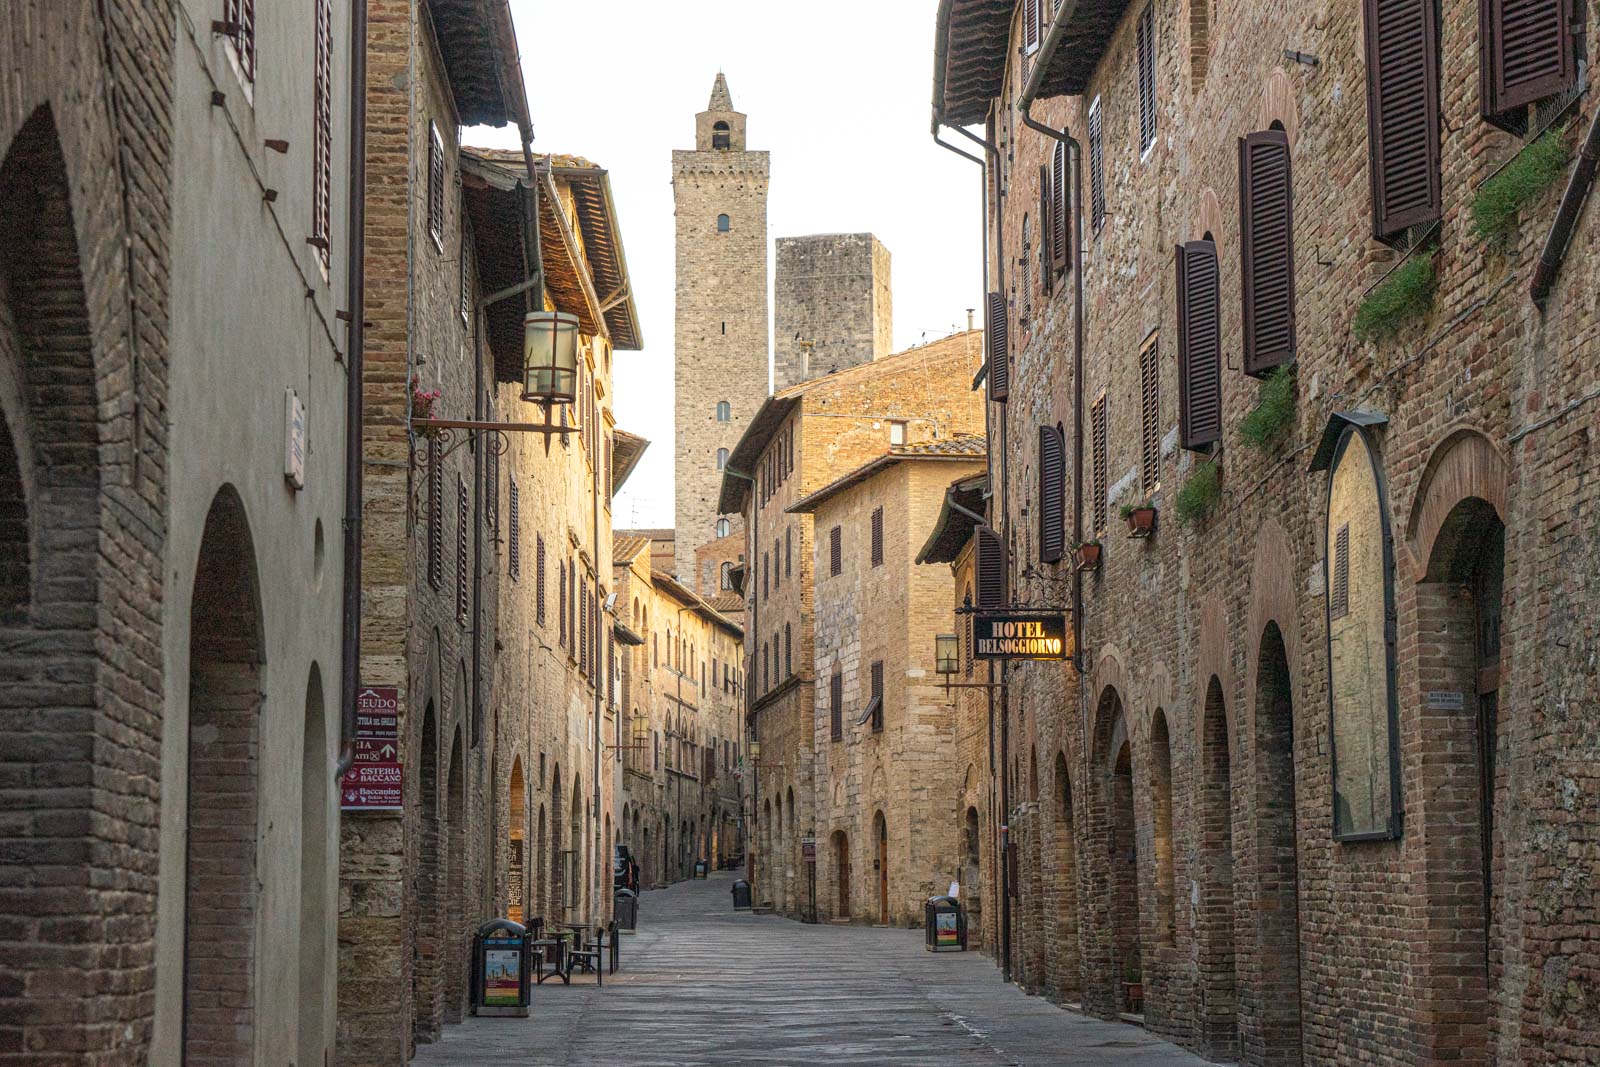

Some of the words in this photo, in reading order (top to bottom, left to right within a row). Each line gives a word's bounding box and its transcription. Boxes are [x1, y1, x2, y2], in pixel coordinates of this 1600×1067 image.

[992, 621, 1045, 638] HOTEL
[978, 638, 1061, 654] BELSOGGIORNO
[360, 767, 400, 775] OSTERIA
[360, 787, 400, 795] Baccanino
